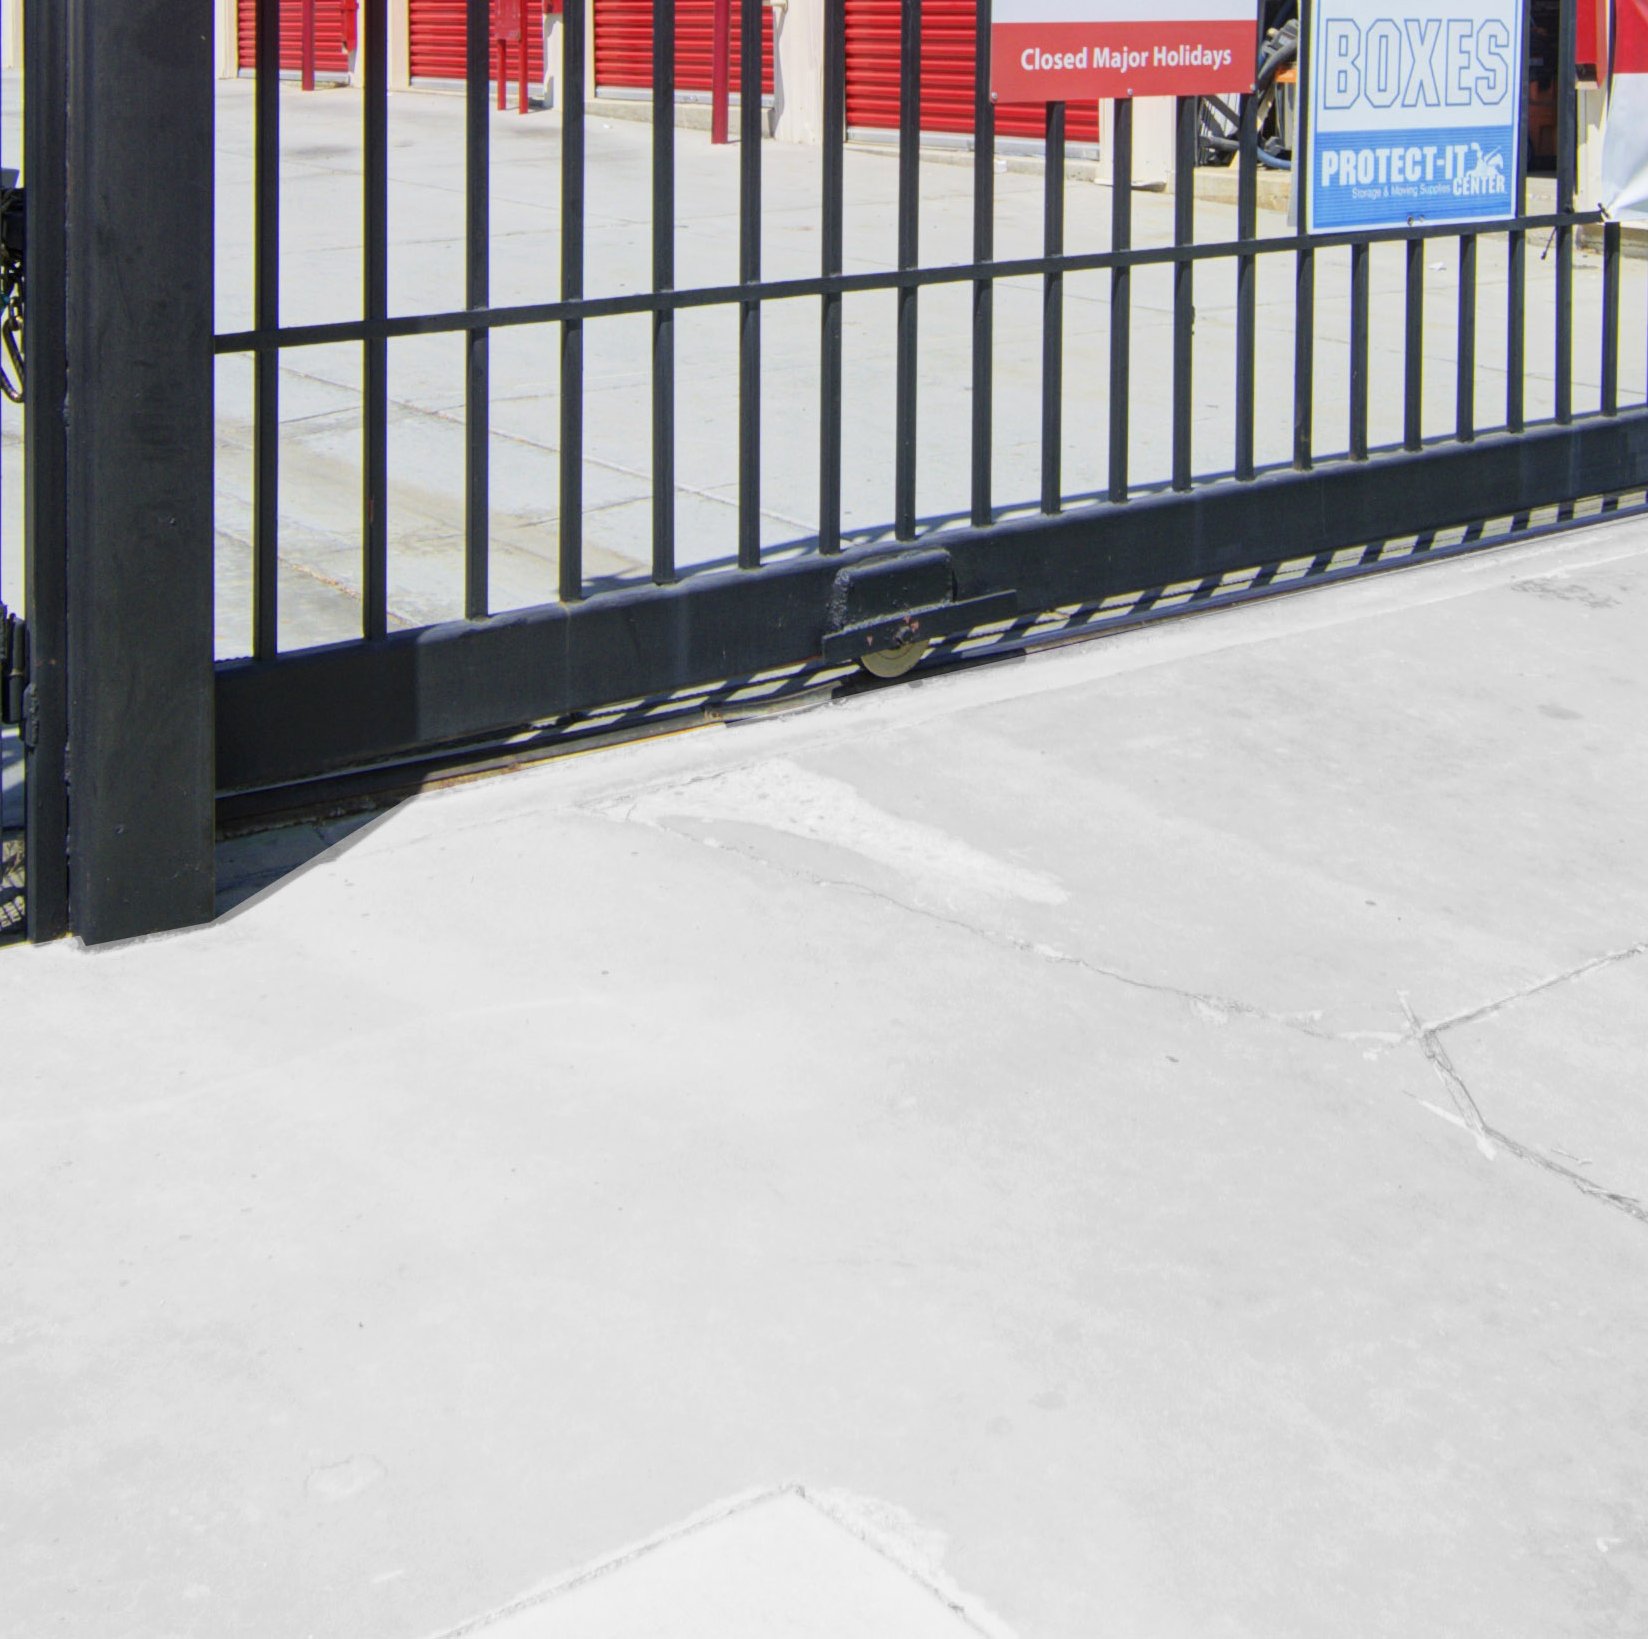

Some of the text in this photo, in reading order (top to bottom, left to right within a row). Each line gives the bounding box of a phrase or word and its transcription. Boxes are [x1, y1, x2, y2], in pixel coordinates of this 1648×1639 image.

[1021, 44, 1231, 73] Closed Major Holidays
[1324, 18, 1509, 109] BOXES
[1322, 145, 1468, 187] PROTECT-IT
[1352, 187, 1381, 200] Storage
[1383, 187, 1388, 197] &
[1391, 185, 1418, 197] Moving
[1453, 175, 1505, 196] CENTER
